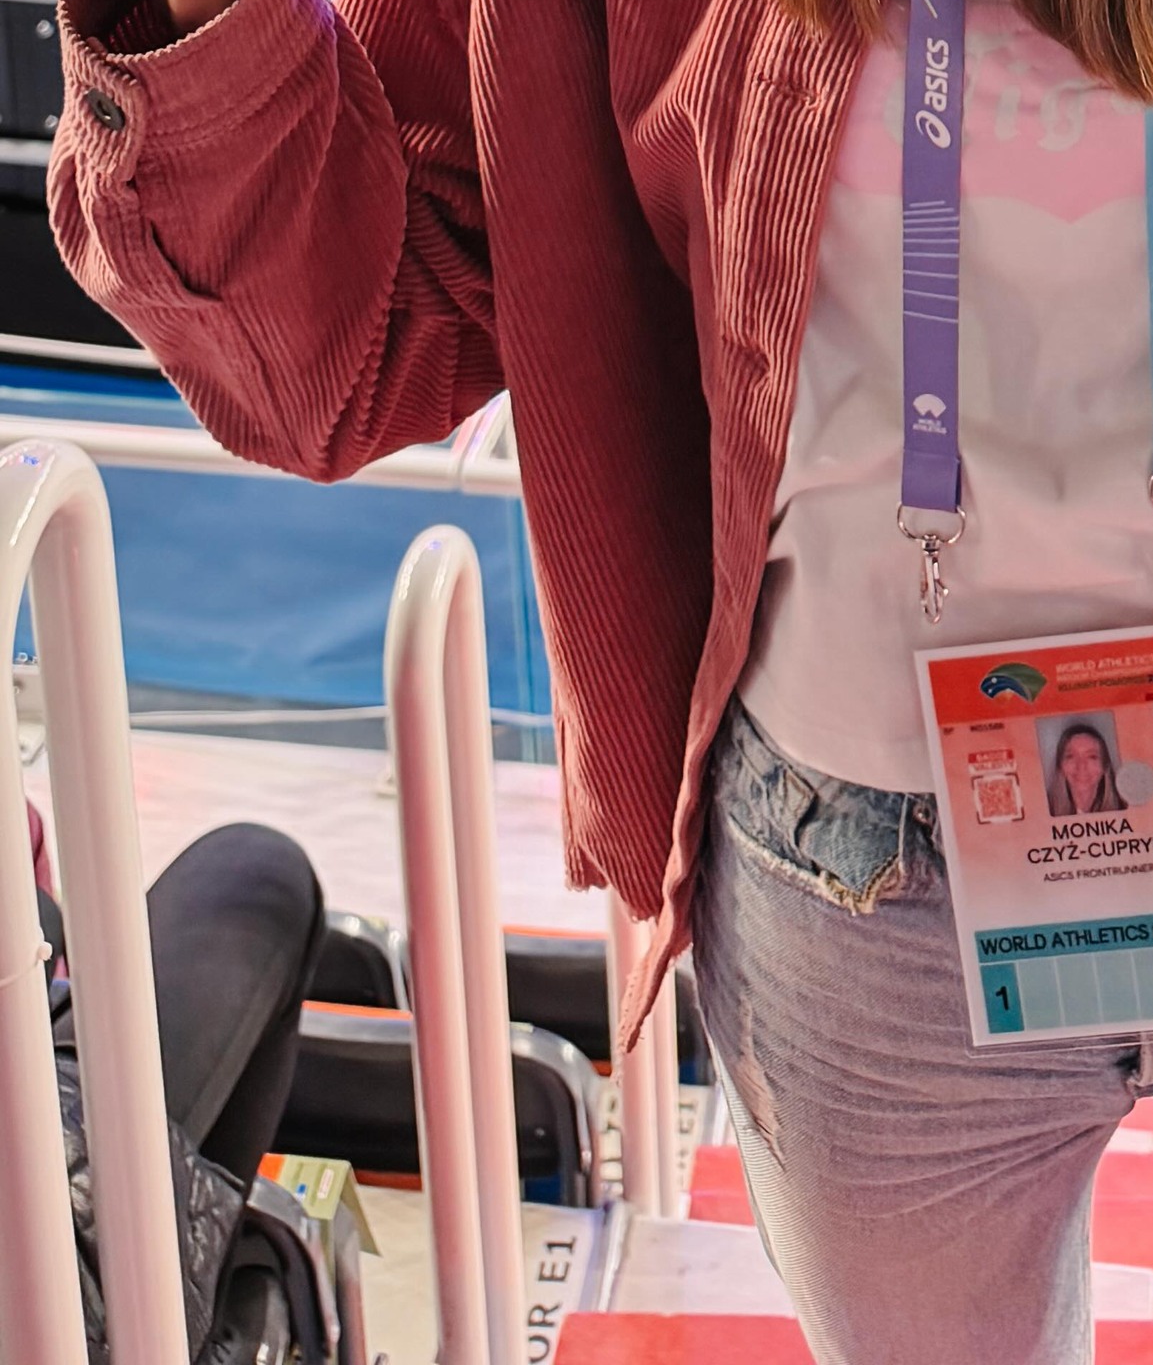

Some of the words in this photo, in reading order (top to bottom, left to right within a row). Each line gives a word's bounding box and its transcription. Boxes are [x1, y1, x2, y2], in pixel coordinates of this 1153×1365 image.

[924, 37, 950, 112] asics
[1052, 818, 1134, 841] MONIKA
[1043, 868, 1075, 882] ASICS
[980, 933, 1047, 957] WORLD
[1051, 923, 1150, 949] ATHLETICS
[995, 985, 1010, 1011] 1
[537, 1234, 578, 1284] E1
